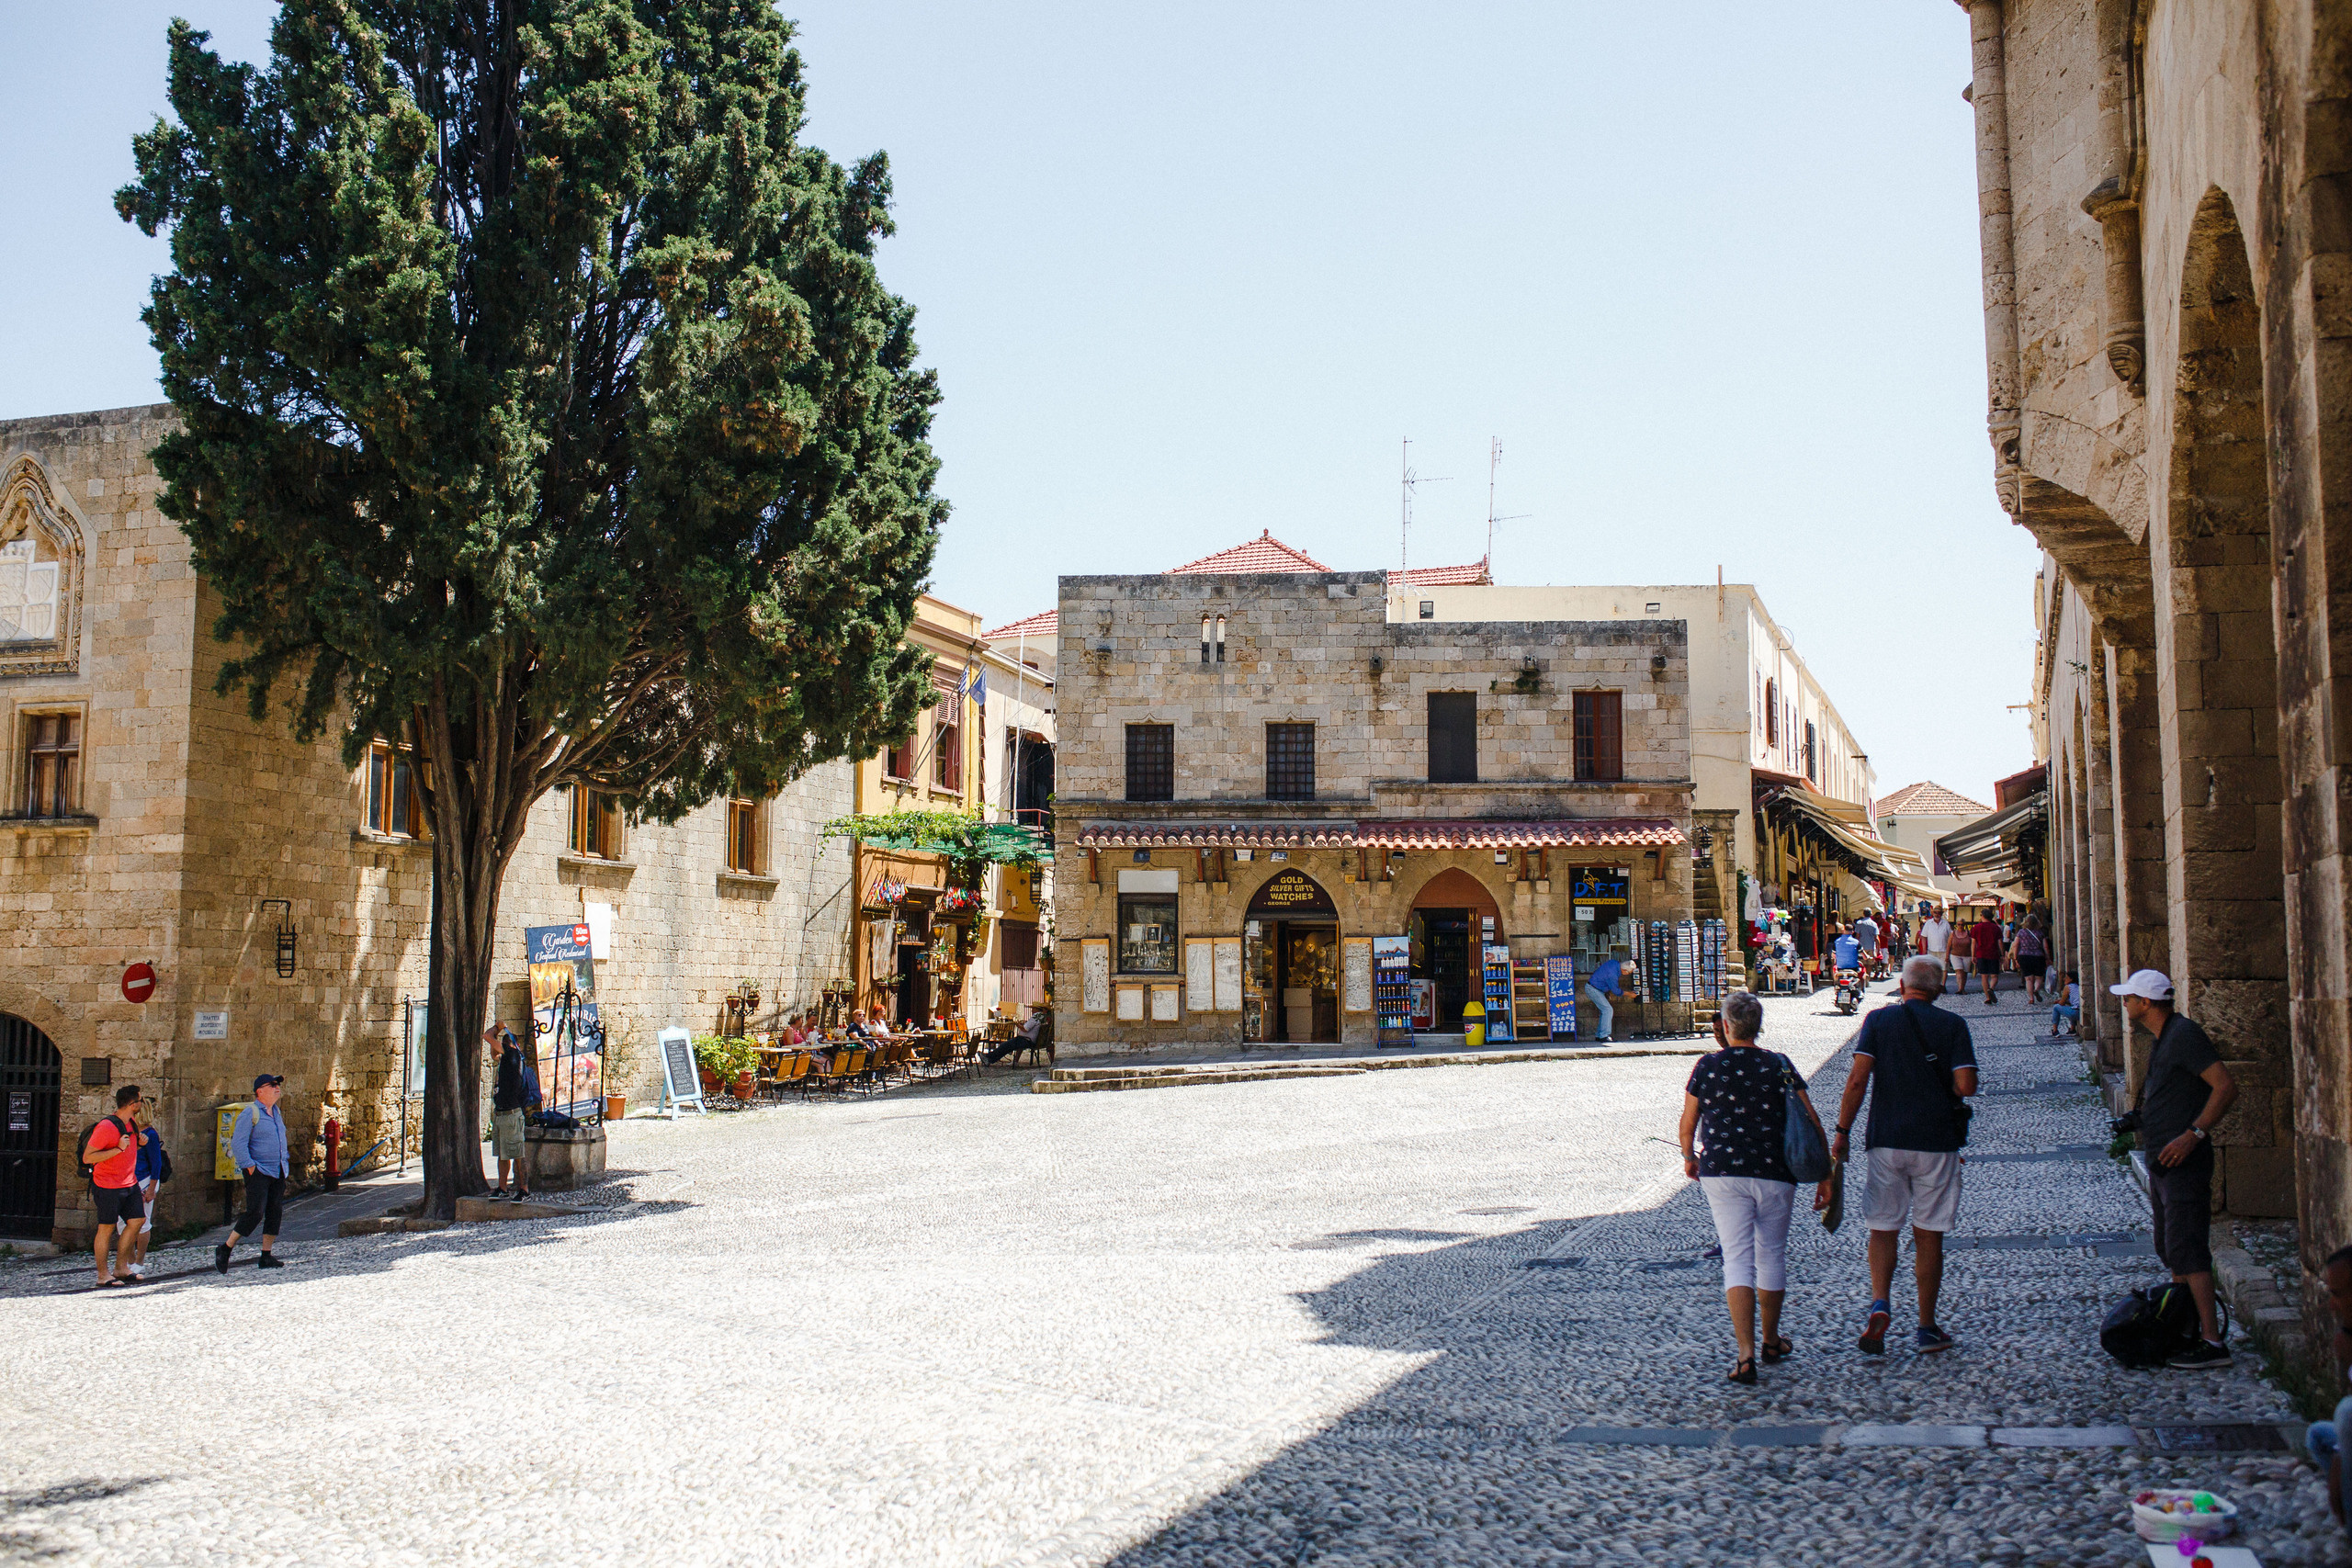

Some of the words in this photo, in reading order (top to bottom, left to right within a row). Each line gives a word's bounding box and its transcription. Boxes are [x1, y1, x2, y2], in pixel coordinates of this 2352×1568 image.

[1574, 882, 1624, 897] D.F.T.
[1270, 893, 1314, 901] WATCHES
[575, 927, 588, 935] 50m
[542, 928, 573, 953] Garden
